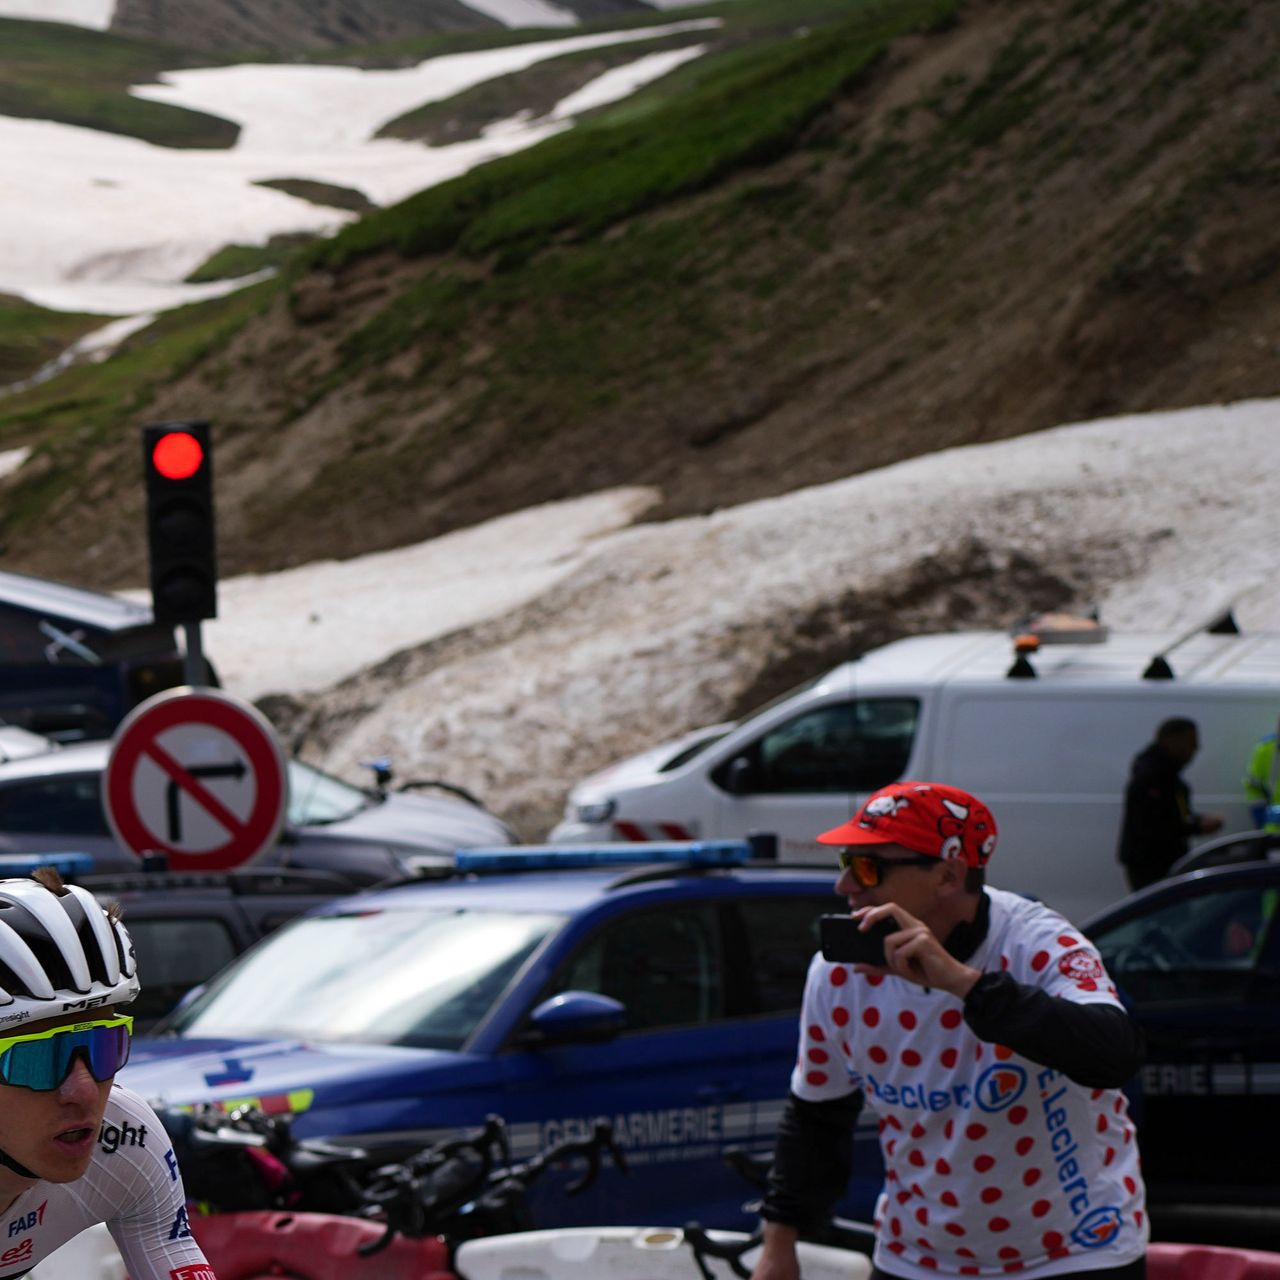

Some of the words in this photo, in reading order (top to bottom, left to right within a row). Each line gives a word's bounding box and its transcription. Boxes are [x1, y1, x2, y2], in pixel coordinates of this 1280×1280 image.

[62, 994, 112, 1013] MET
[543, 1106, 722, 1150] GENARMERIE
[7, 1210, 39, 1239] FAB
